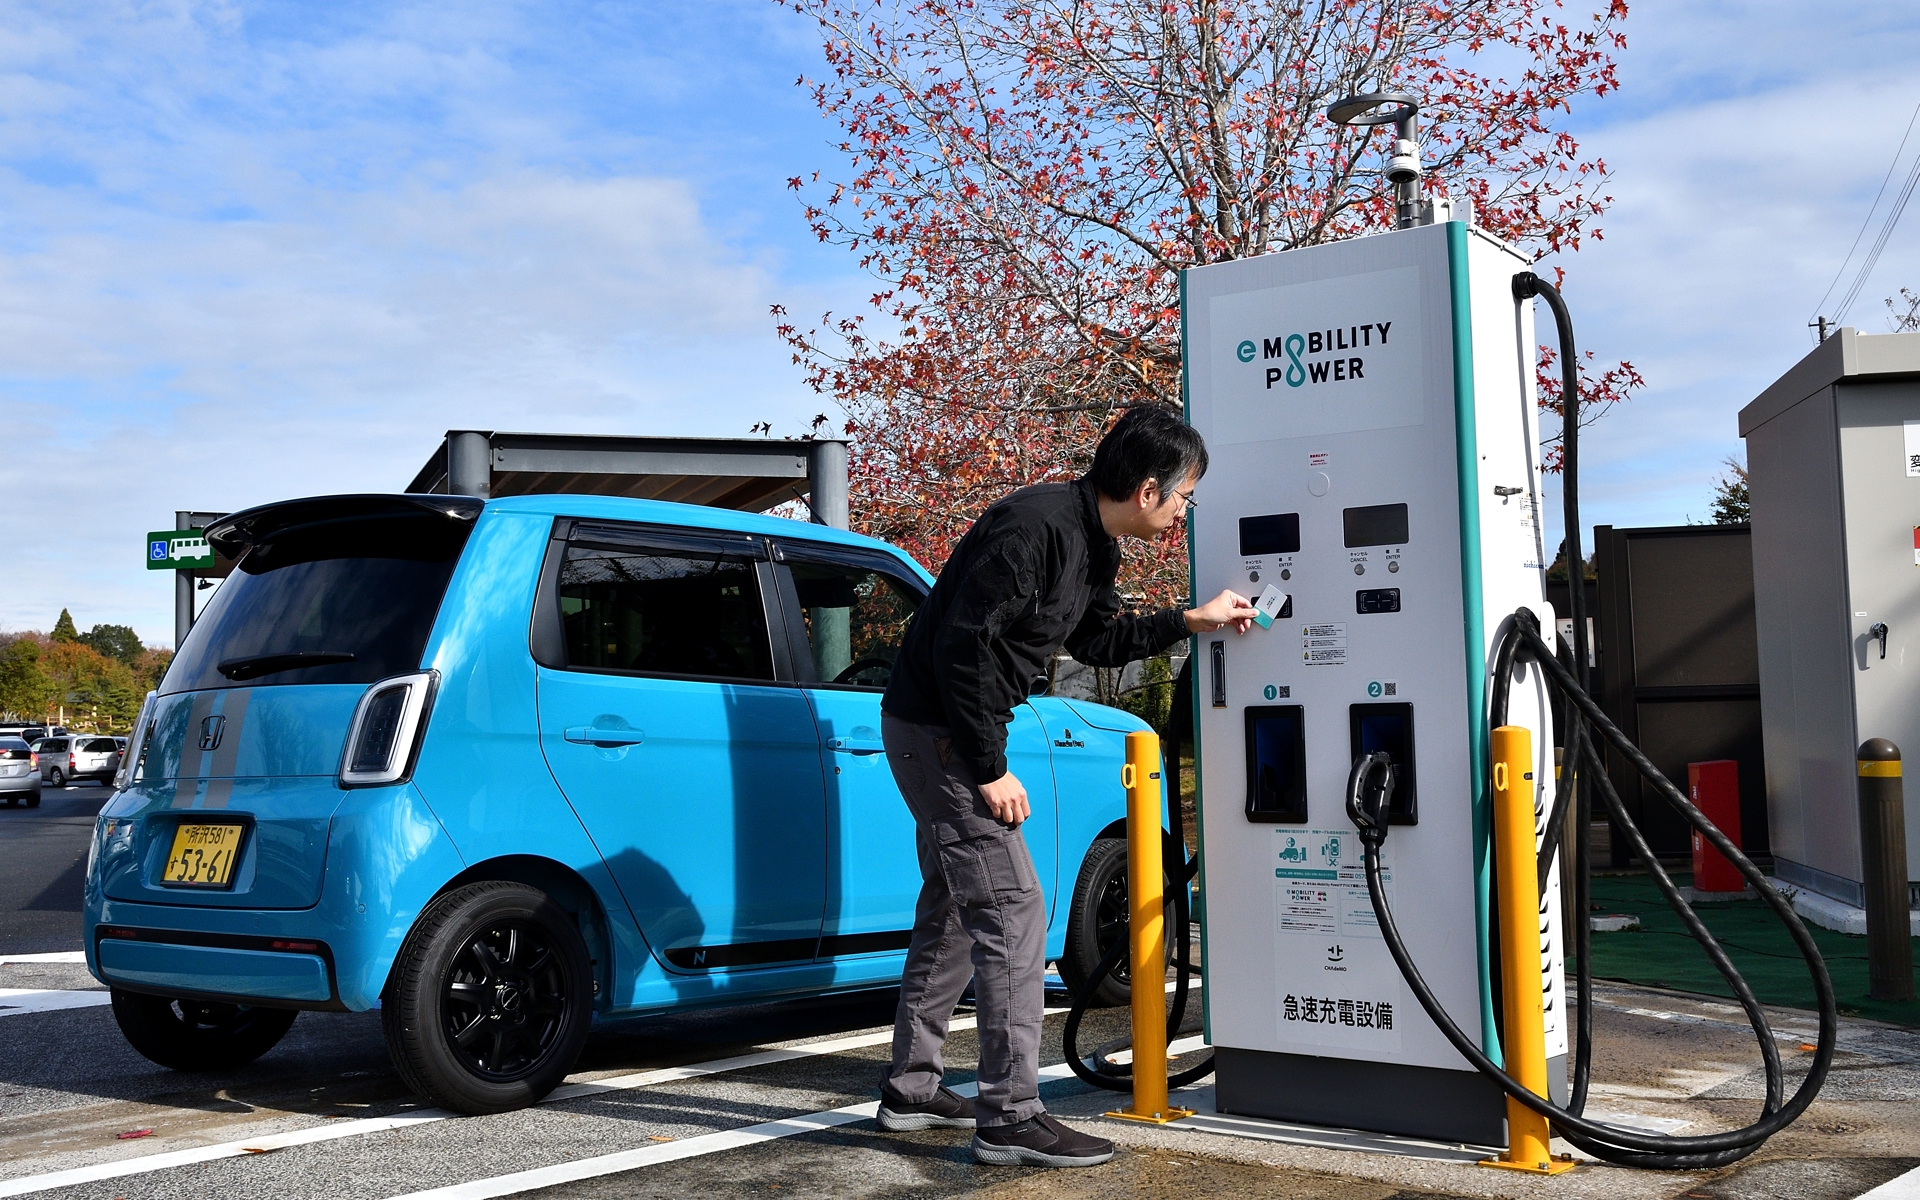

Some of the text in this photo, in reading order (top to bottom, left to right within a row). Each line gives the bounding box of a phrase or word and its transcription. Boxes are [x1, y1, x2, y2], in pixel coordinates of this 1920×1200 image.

[1263, 321, 1392, 360] MOBILITY
[1266, 357, 1365, 390] POWER
[177, 848, 231, 883] 53-61
[1283, 993, 1394, 1031] 急速充電設備
